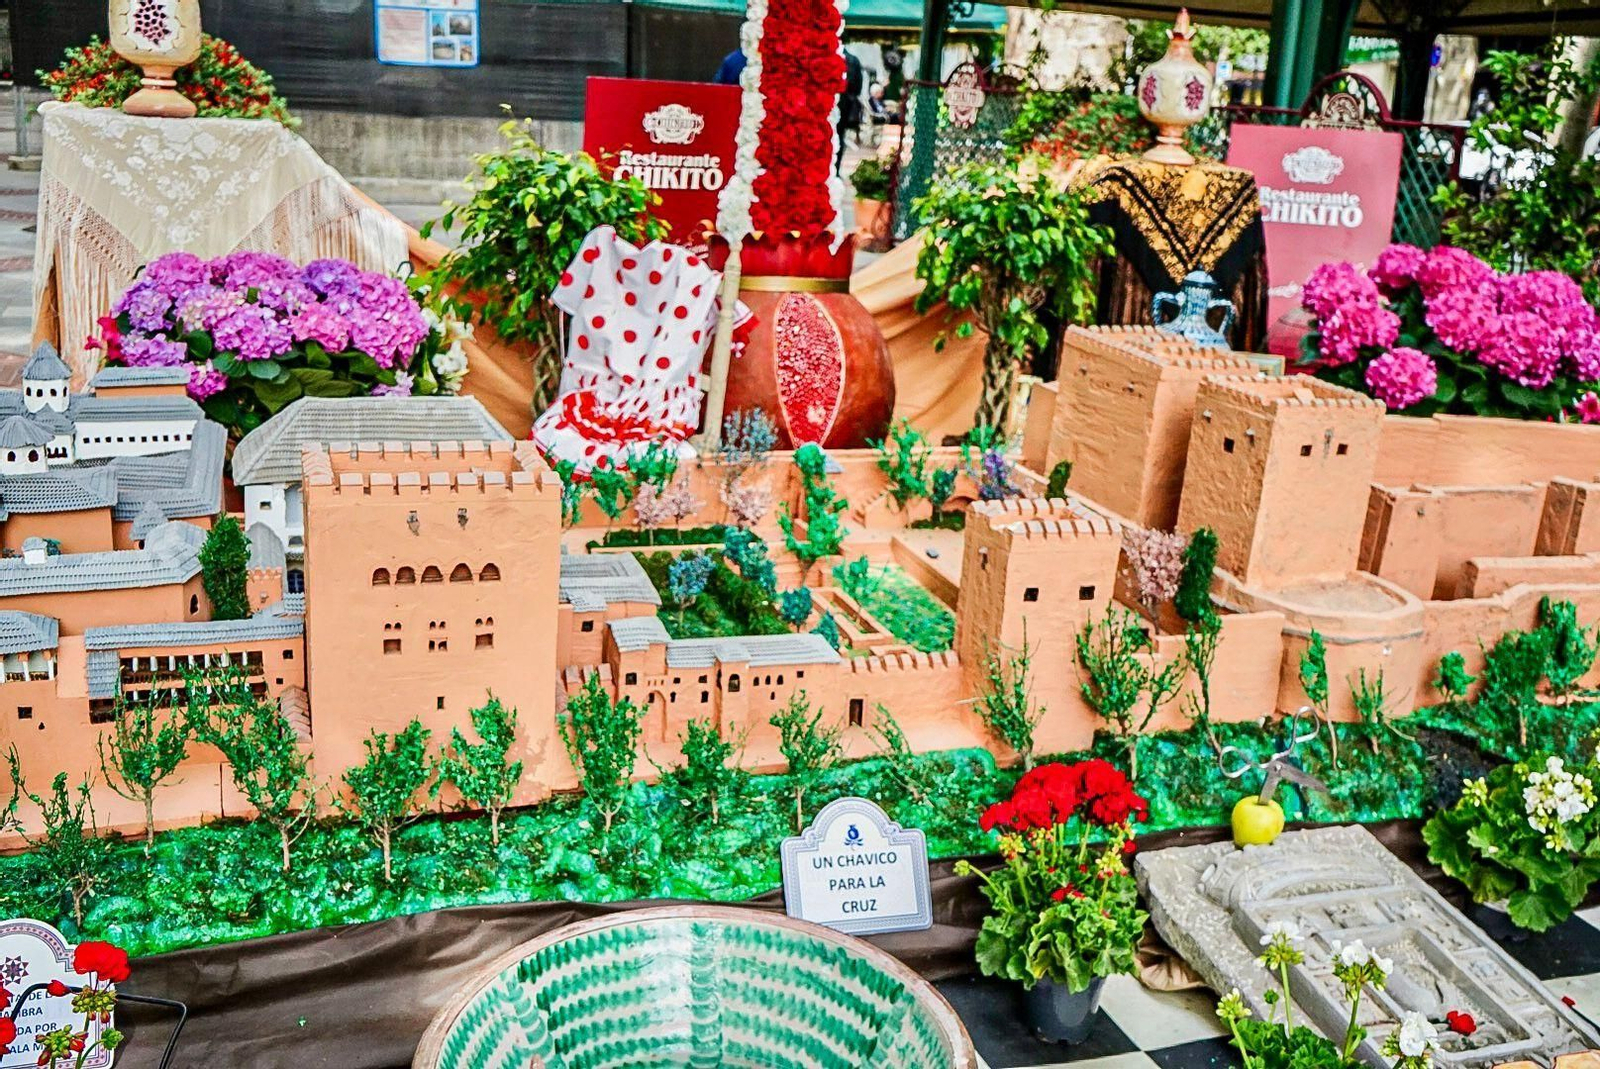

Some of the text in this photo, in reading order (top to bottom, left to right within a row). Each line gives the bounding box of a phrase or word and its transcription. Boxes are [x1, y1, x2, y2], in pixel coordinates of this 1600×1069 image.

[619, 150, 721, 168] Restaurante
[613, 165, 724, 190] CHIKITO
[1259, 186, 1361, 207] Restaurante
[1260, 202, 1364, 228] CHIKITO
[812, 851, 897, 869] UN CHAVICO
[829, 875, 886, 891] PARA LA
[842, 899, 877, 913] CRUZ
[35, 1022, 57, 1033] POR
